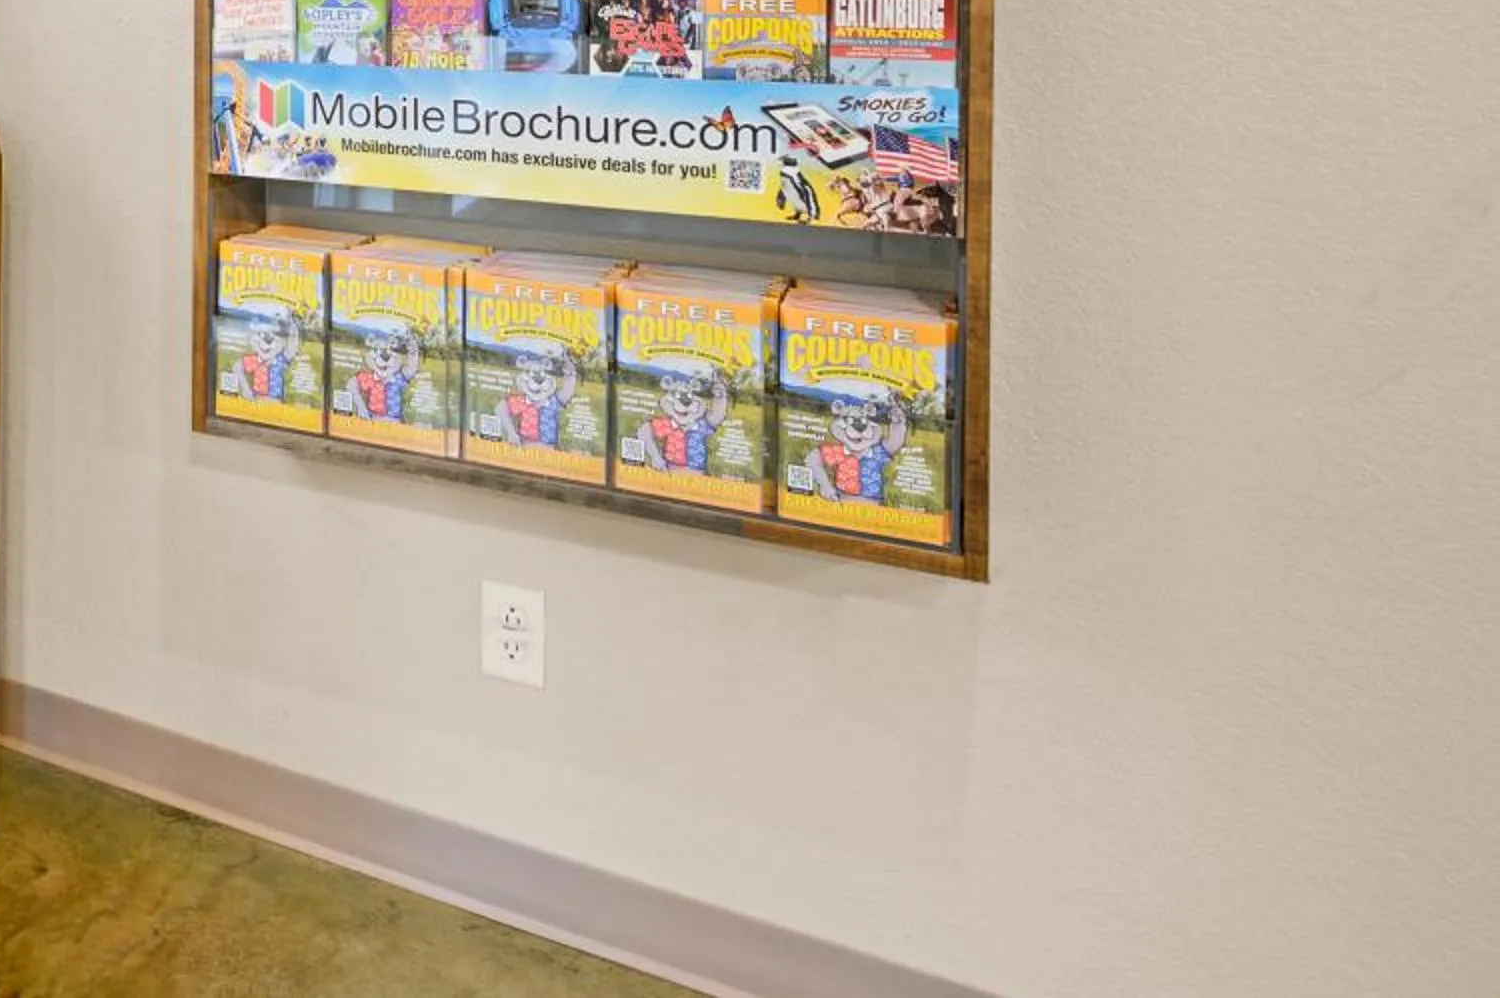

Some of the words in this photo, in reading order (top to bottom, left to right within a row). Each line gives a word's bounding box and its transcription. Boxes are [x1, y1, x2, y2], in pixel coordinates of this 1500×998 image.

[706, 17, 813, 57] COUPONS
[835, 27, 946, 40] ATTRACTIONS
[311, 90, 778, 155] MobileBrochure.com
[838, 94, 928, 116] SMOKIES
[875, 109, 902, 124] TO
[903, 105, 947, 125] GO!
[341, 136, 488, 164] Mobilebrochure.com
[491, 147, 519, 165] has
[523, 150, 597, 171] exclusive
[601, 156, 646, 176] deals
[650, 158, 677, 176] for
[679, 162, 717, 181] you!
[233, 252, 305, 271] FREE
[222, 265, 320, 314] COUPONS
[335, 278, 441, 327] COUPONS
[493, 283, 581, 307] FREE
[481, 297, 600, 348] COUPONS
[637, 298, 736, 324] FREE
[805, 317, 916, 344] FREE
[621, 314, 755, 368] COUPONS
[787, 332, 936, 391] COUPONS
